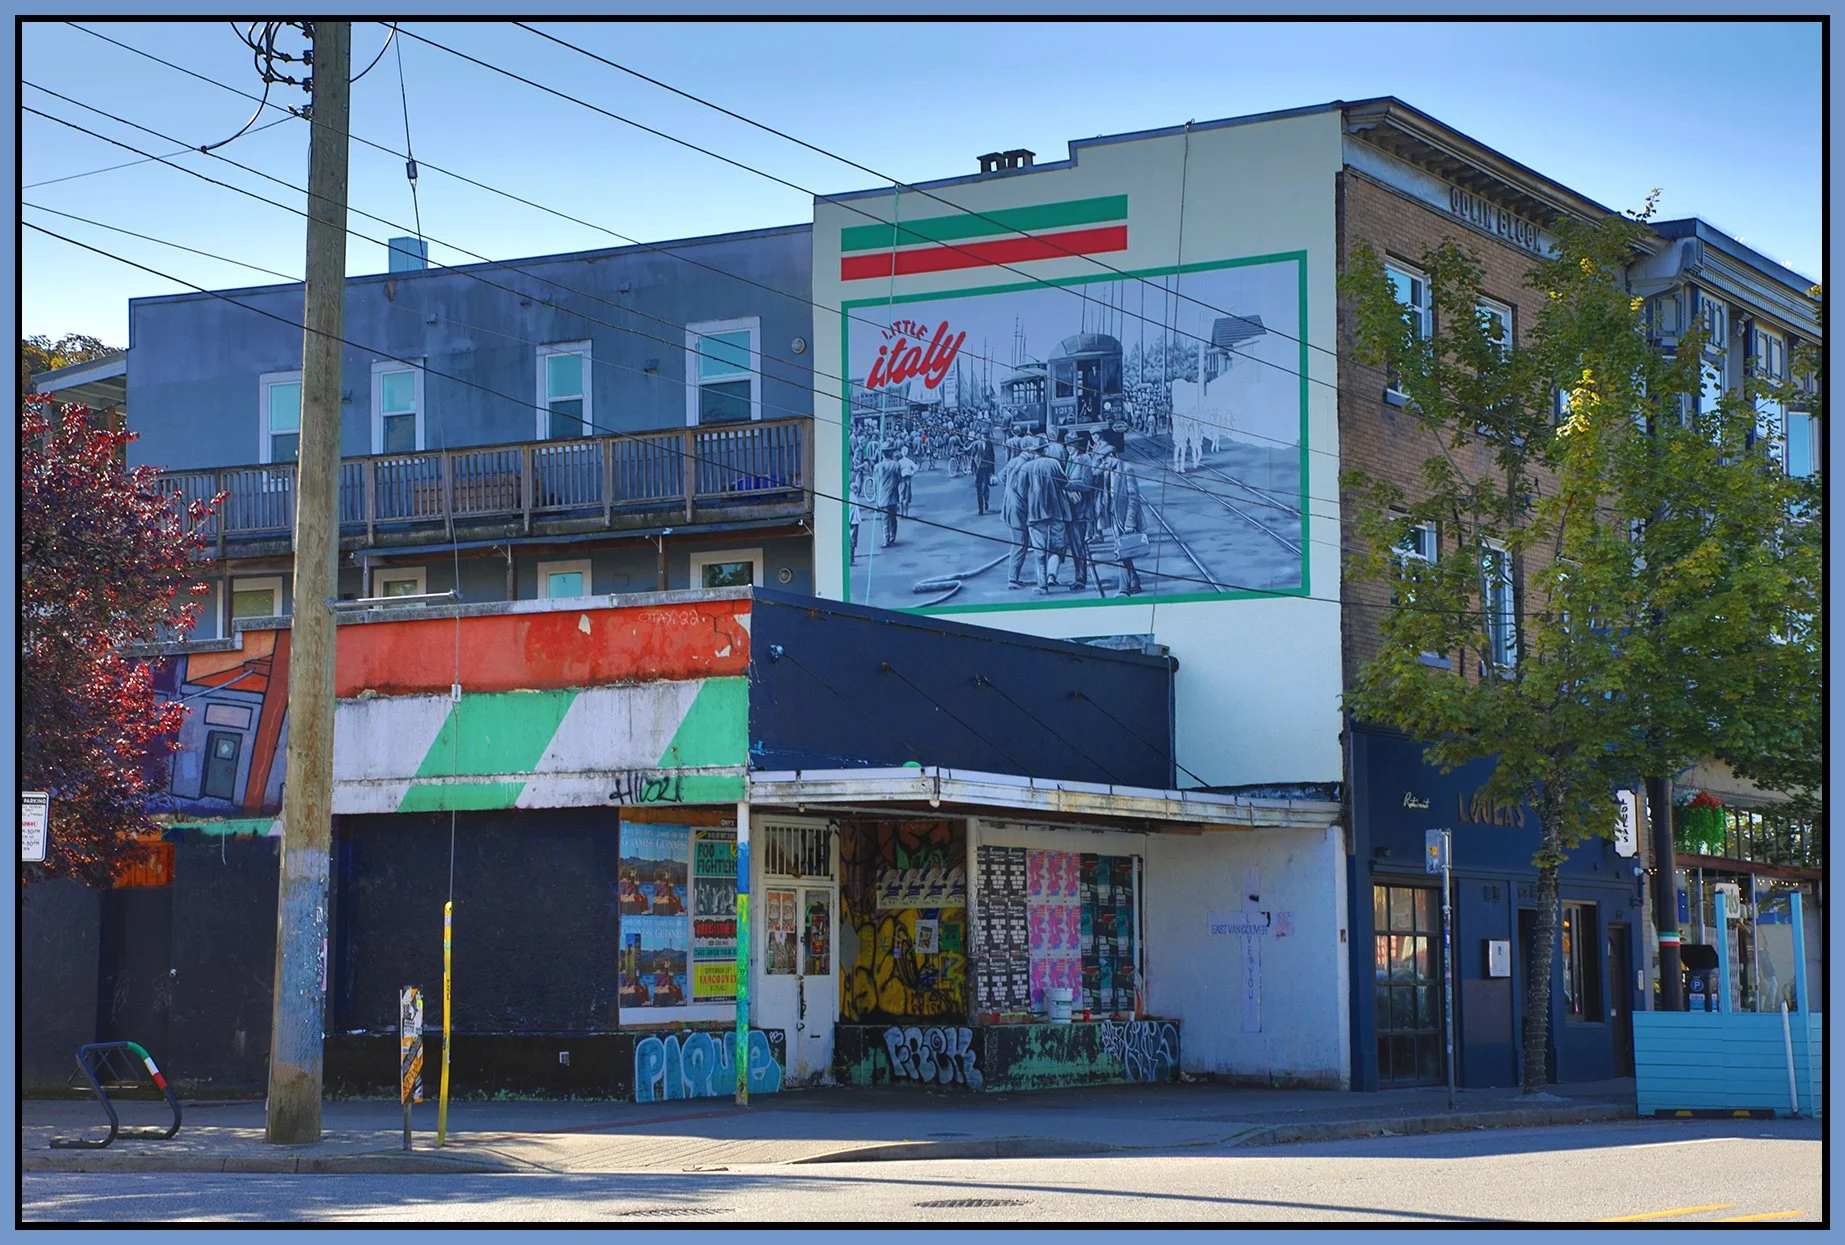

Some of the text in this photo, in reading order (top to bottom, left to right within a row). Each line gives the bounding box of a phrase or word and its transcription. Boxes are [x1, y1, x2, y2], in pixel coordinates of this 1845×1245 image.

[881, 319, 928, 341] LITTLE
[866, 320, 966, 390] italy
[697, 843, 715, 858] FOO
[697, 859, 737, 874] FIGHTER
